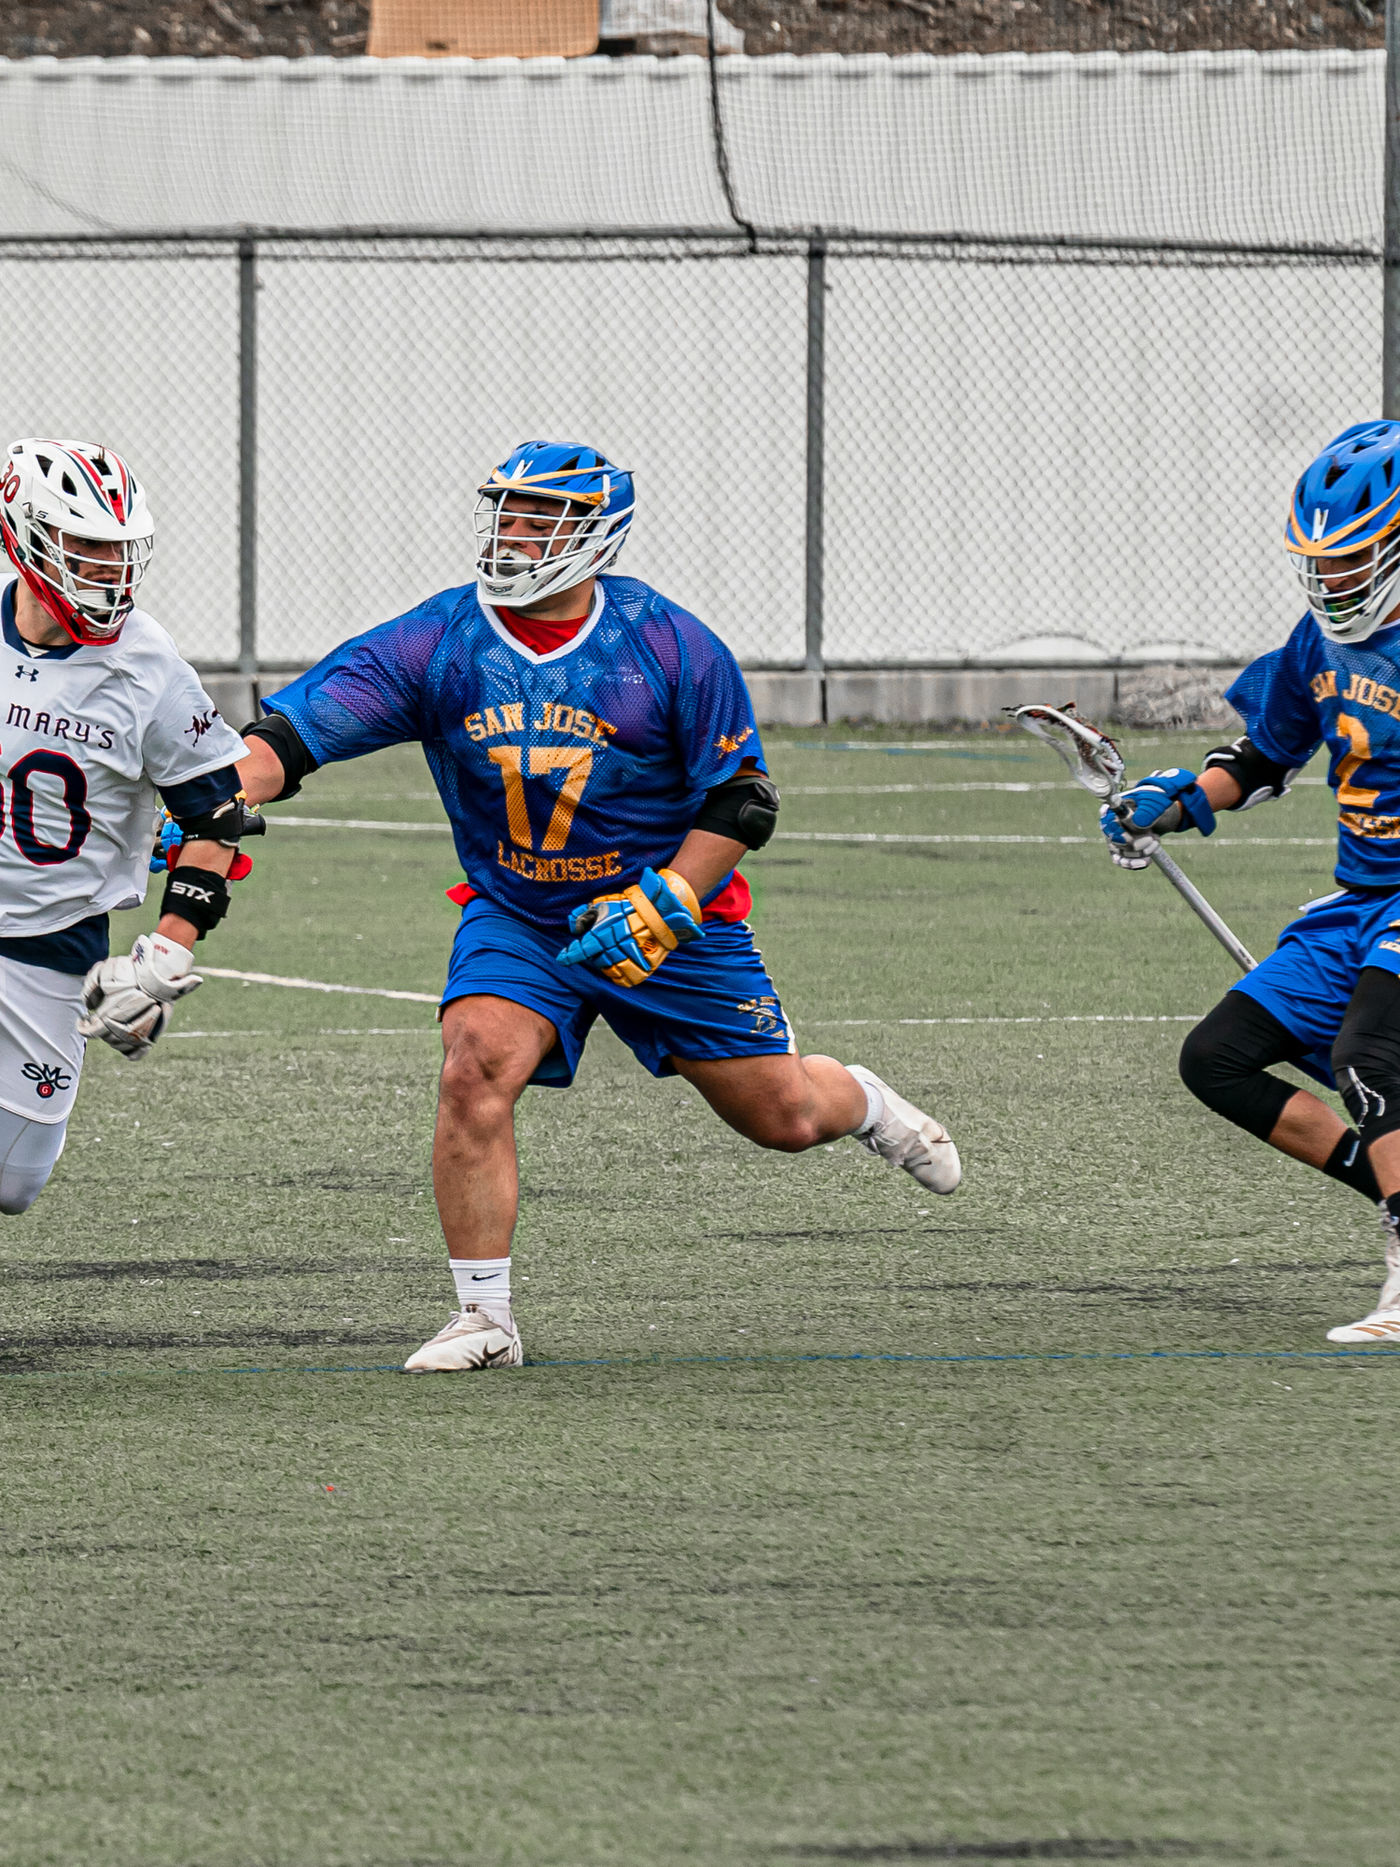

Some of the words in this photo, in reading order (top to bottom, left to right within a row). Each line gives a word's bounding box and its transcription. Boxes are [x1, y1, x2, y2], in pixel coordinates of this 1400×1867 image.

[6, 703, 115, 749] MARY'S
[464, 702, 525, 742] SAN
[533, 702, 618, 748] JOSE
[1335, 712, 1381, 808] 2
[488, 745, 593, 850] 17
[497, 840, 622, 882] LACROSSE
[170, 881, 215, 904] STX
[21, 1063, 72, 1090] SMC
